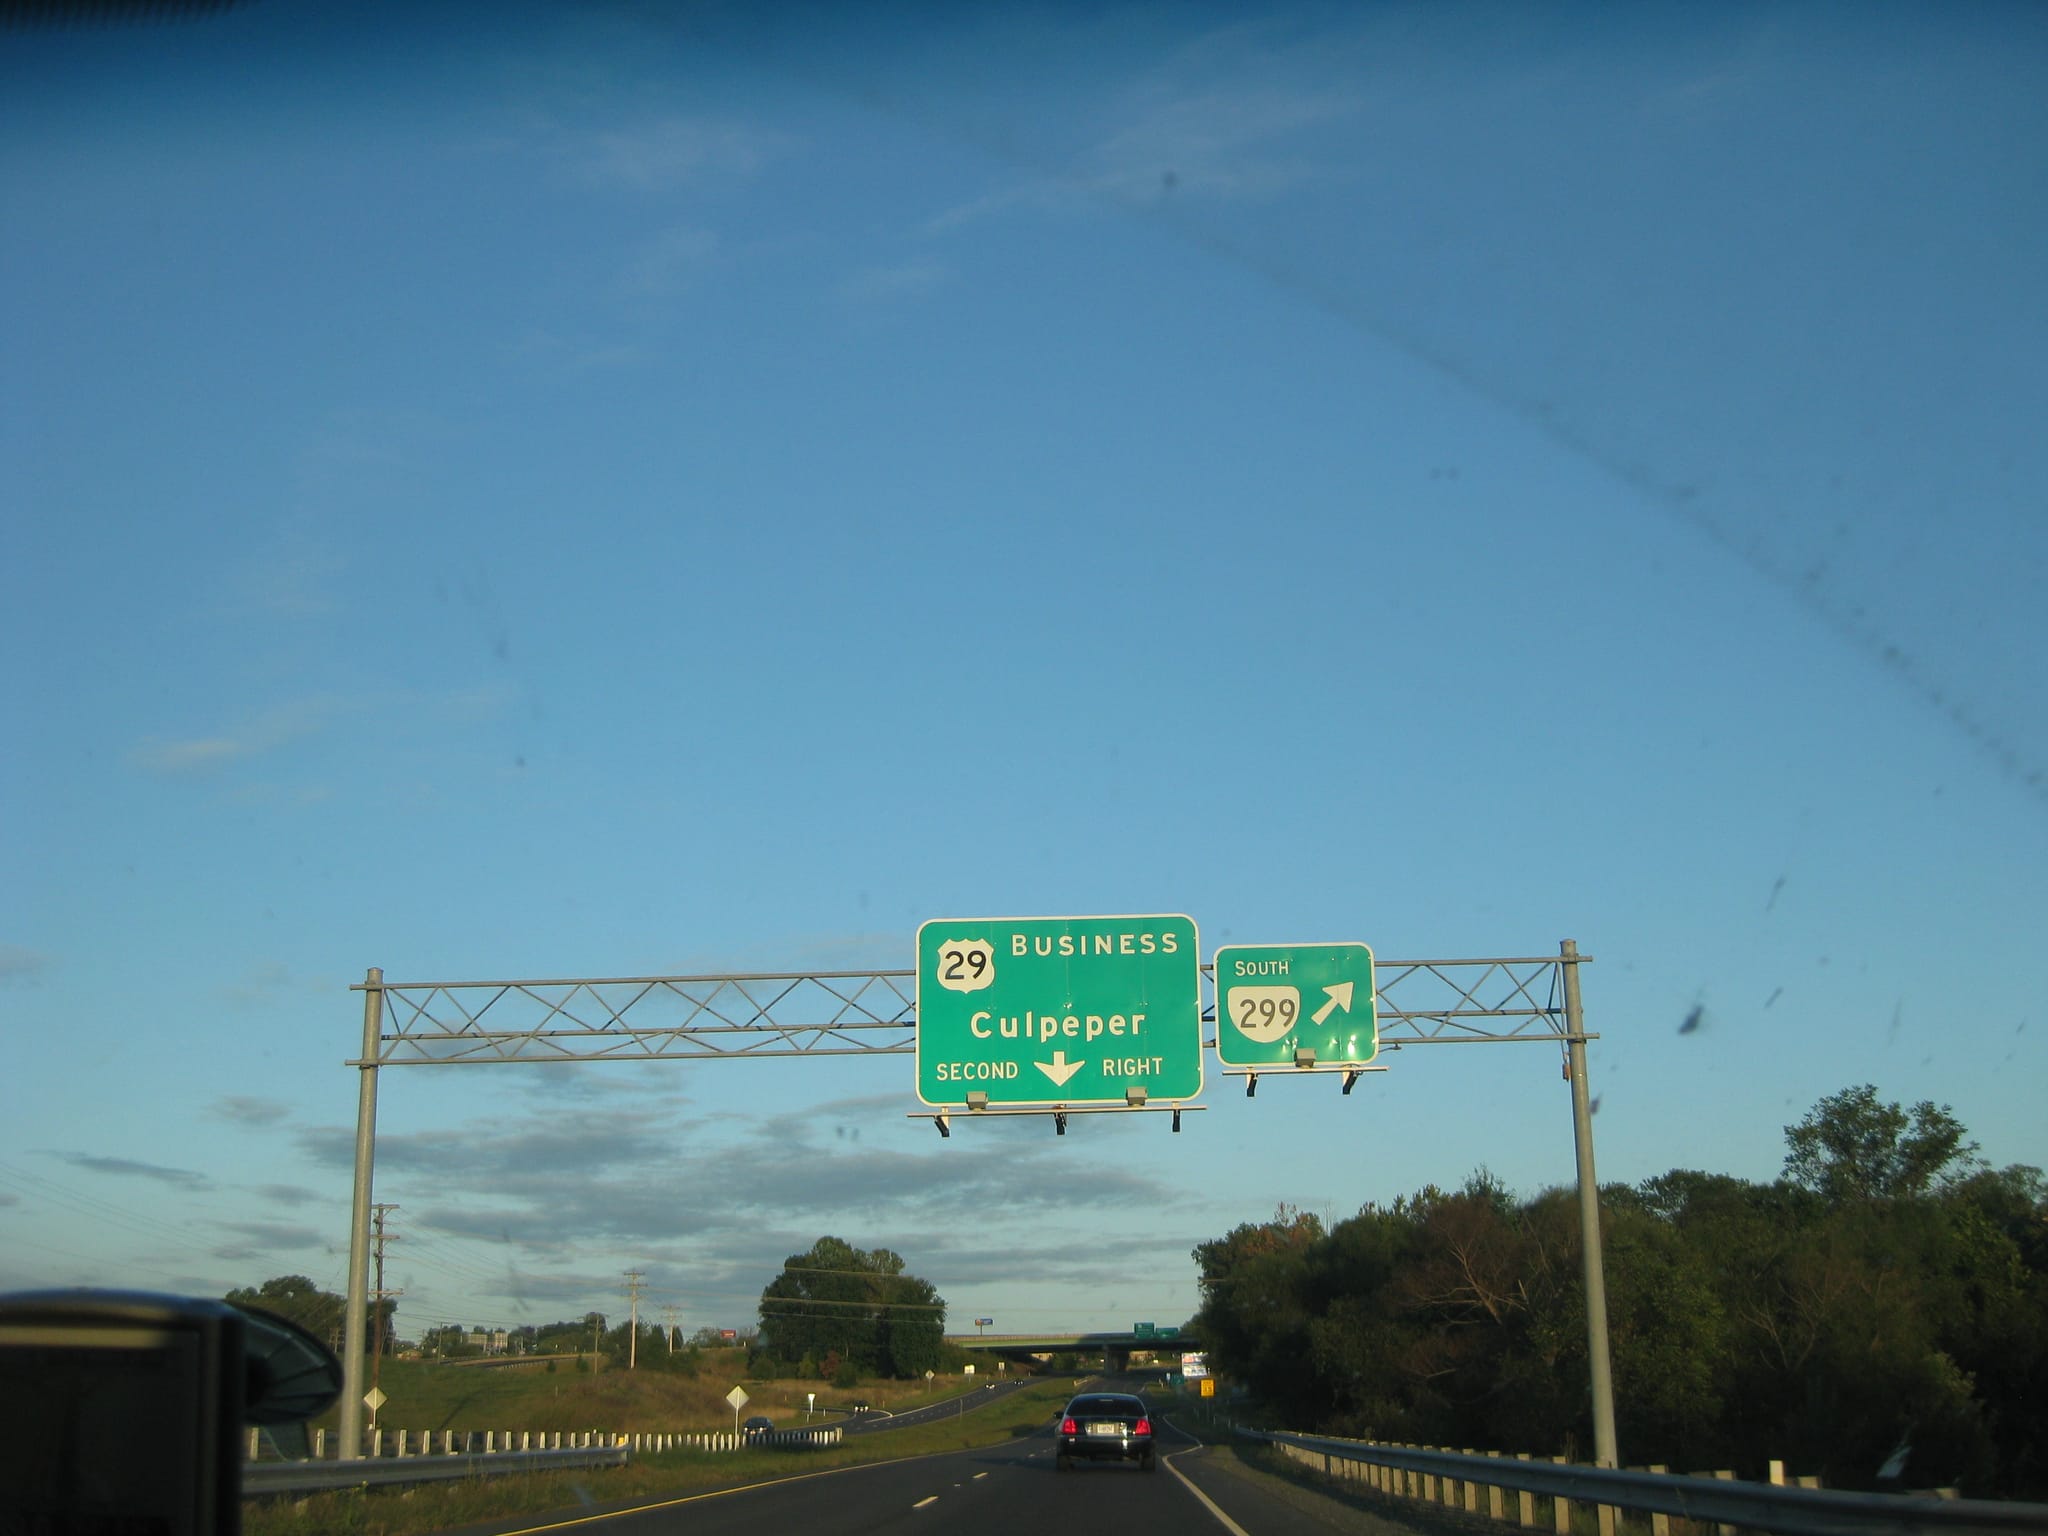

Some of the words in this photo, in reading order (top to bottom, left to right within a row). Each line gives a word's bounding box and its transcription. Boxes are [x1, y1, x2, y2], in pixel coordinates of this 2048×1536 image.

[1012, 933, 1179, 957] BUSINESS
[944, 950, 988, 981] 29
[1235, 960, 1290, 977] SOUTH
[970, 1011, 1146, 1043] Culpeper
[1239, 998, 1296, 1029] 299
[936, 1062, 1019, 1081] SECOND
[1103, 1057, 1163, 1077] RIGHT
